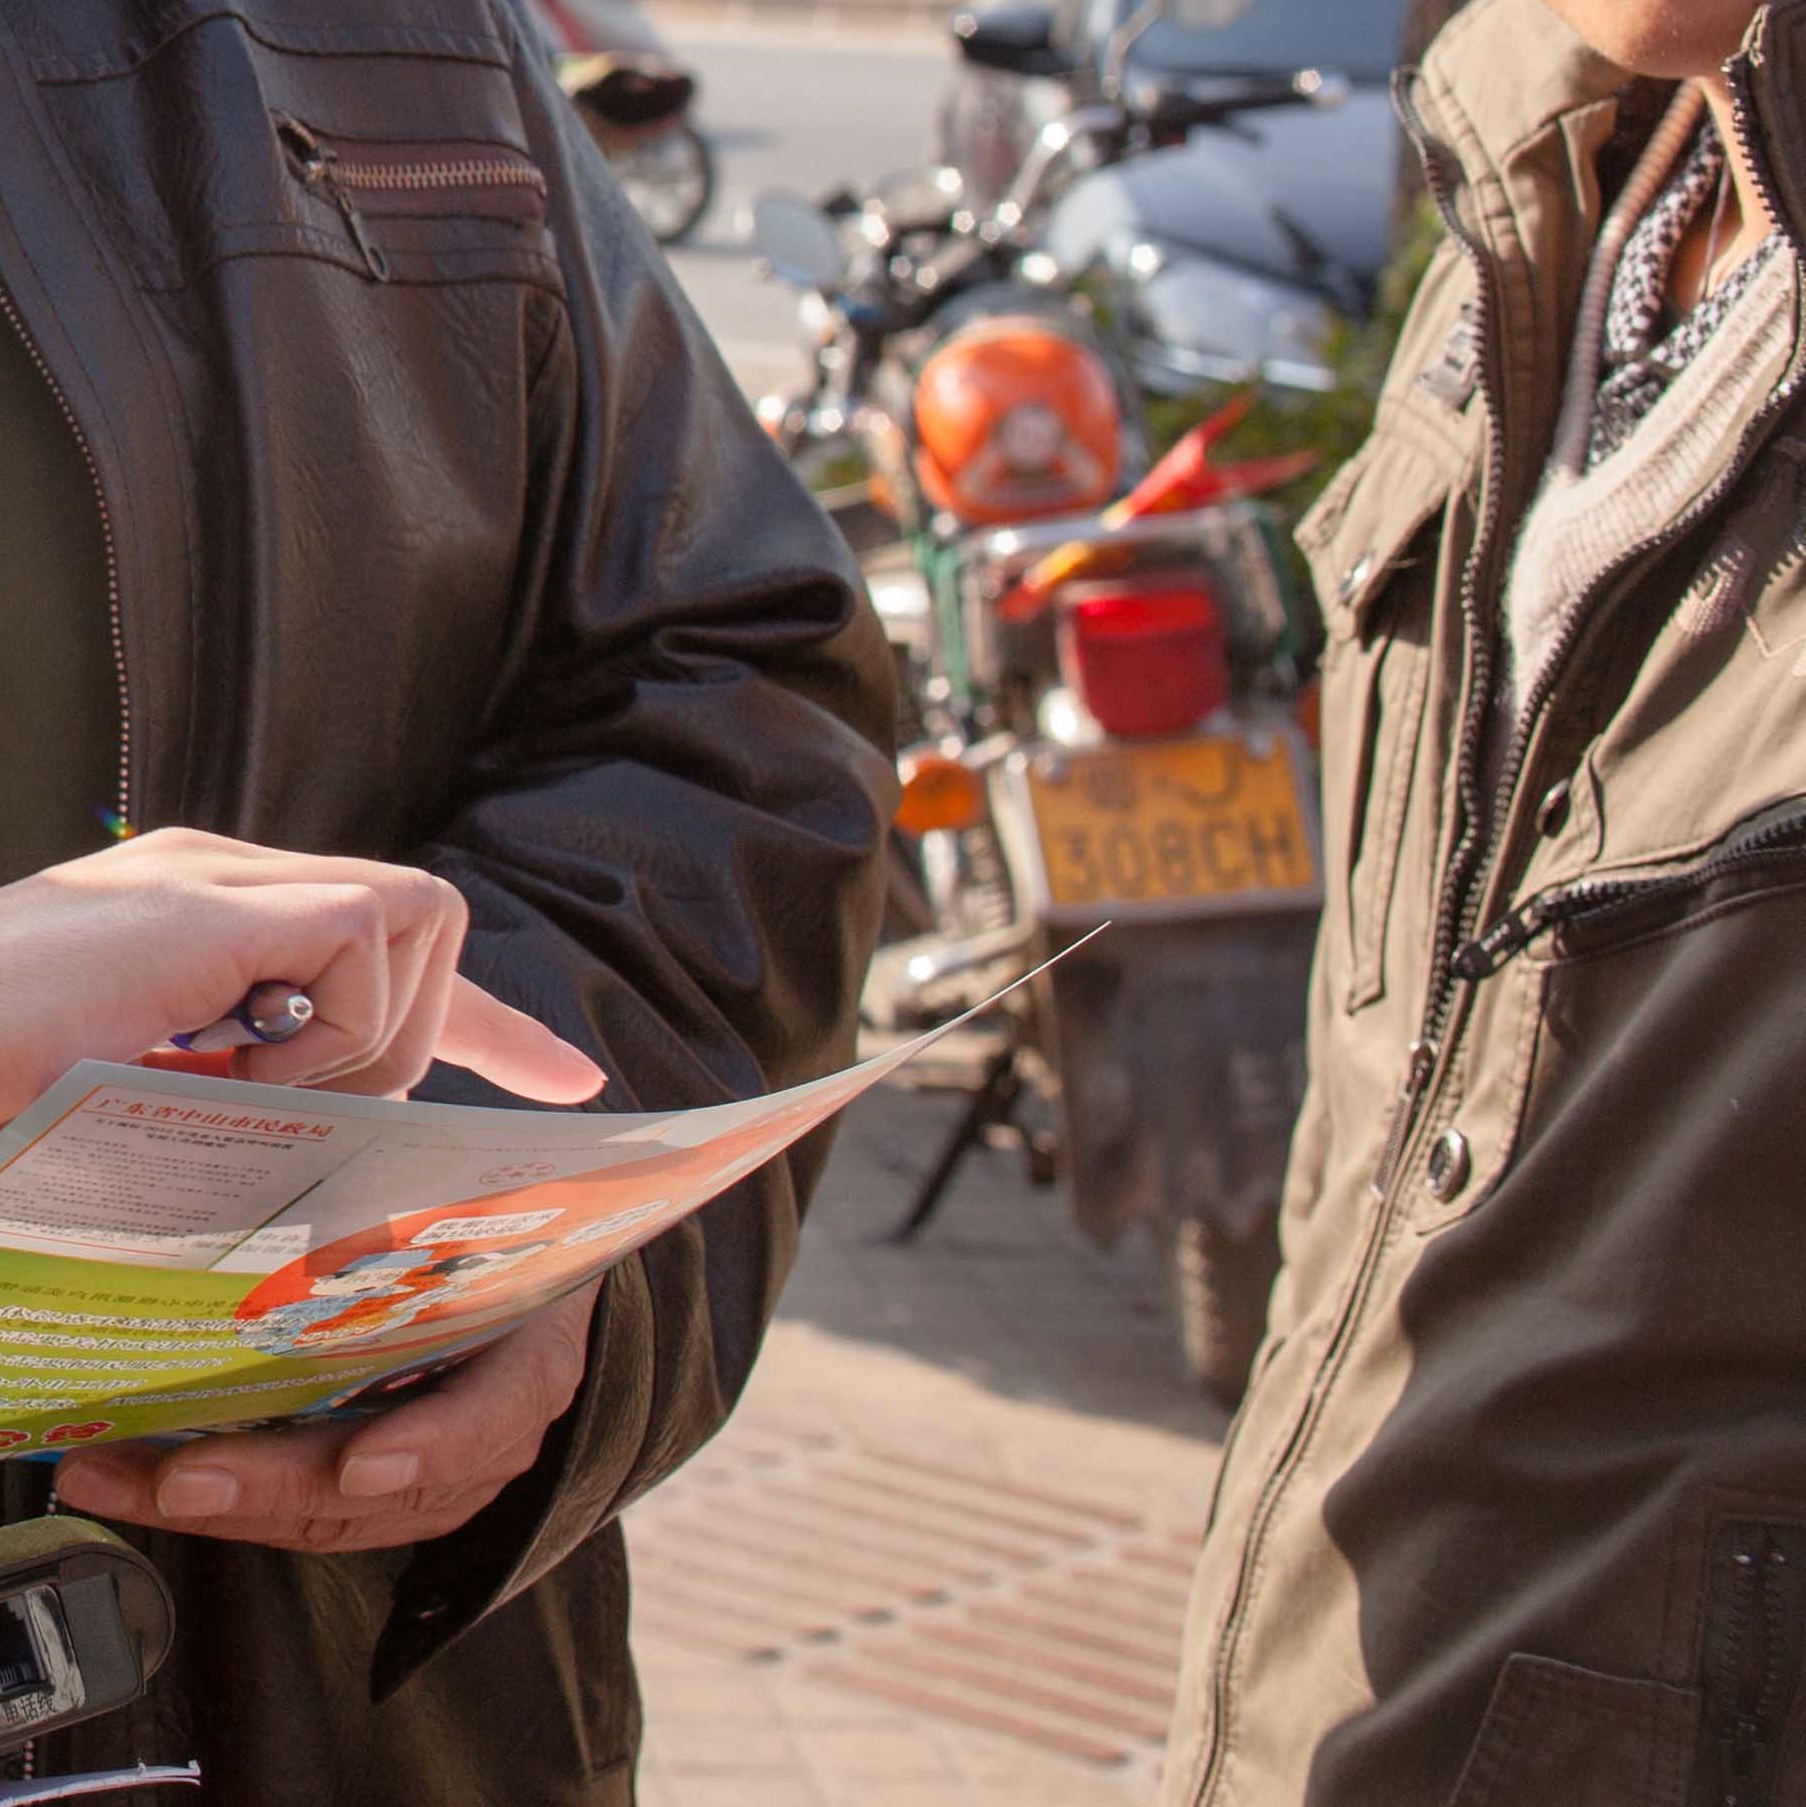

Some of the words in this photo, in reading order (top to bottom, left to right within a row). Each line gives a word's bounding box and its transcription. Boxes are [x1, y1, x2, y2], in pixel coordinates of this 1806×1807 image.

[95, 1096, 334, 1136] 广东省中山市民政局
[3, 1692, 58, 1724] 电话线
